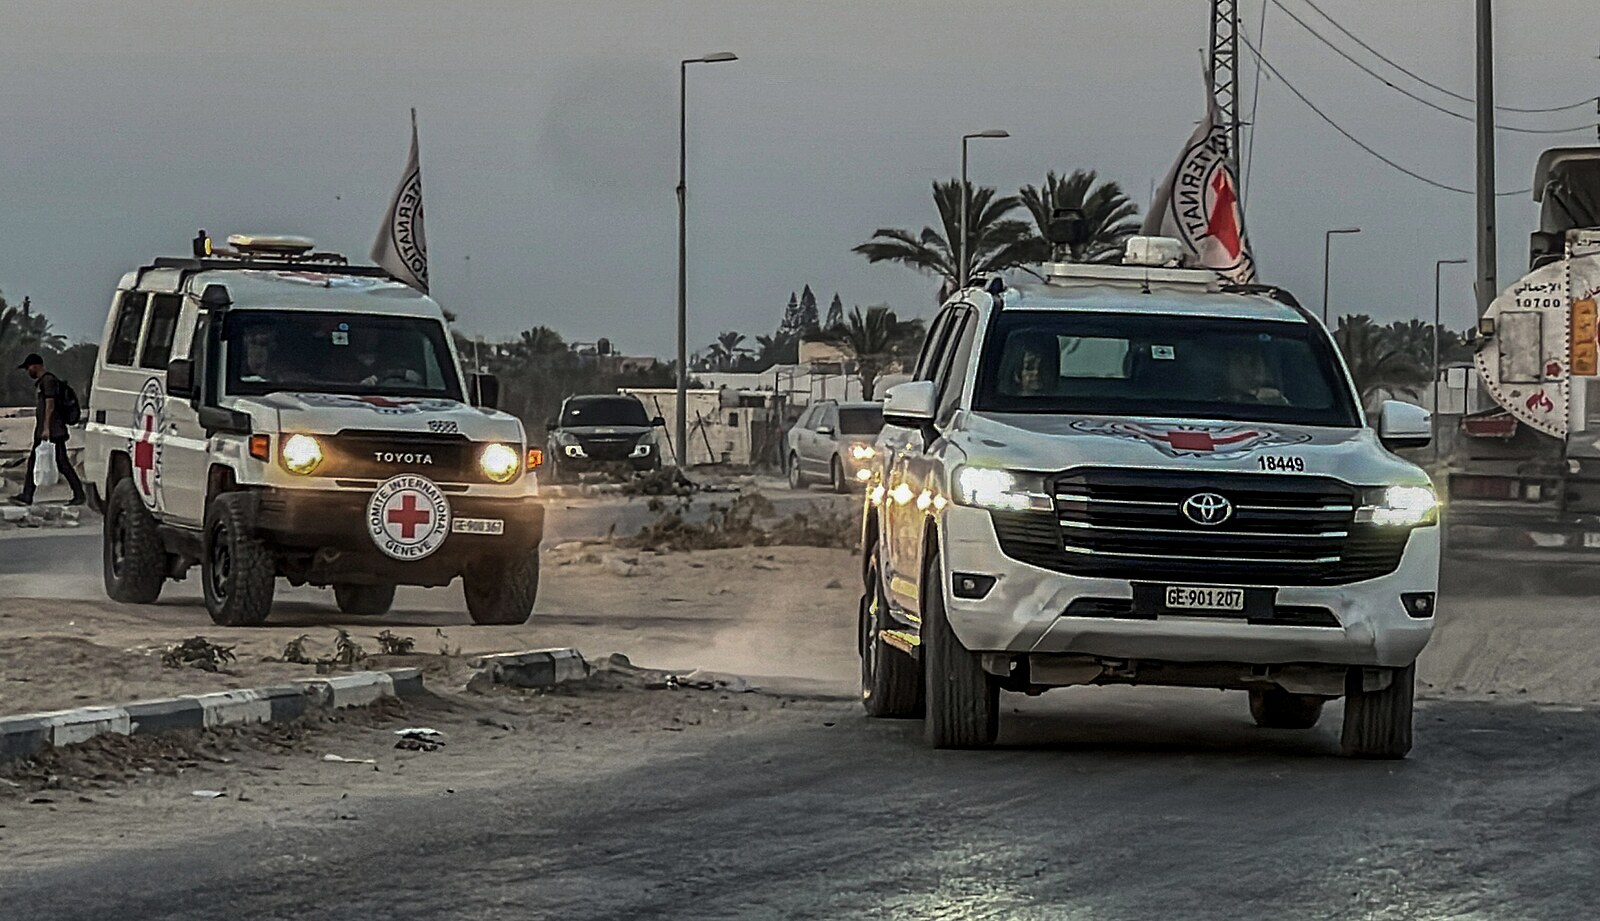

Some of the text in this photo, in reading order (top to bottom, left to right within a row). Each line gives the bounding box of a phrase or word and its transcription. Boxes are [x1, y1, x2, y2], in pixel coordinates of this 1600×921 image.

[1515, 298, 1561, 308] 10700
[374, 452, 433, 464] TOYOTA
[1257, 455, 1305, 472] 18449
[370, 477, 447, 536] COMITE INTERNATIONAL
[385, 539, 432, 557] GENEVE
